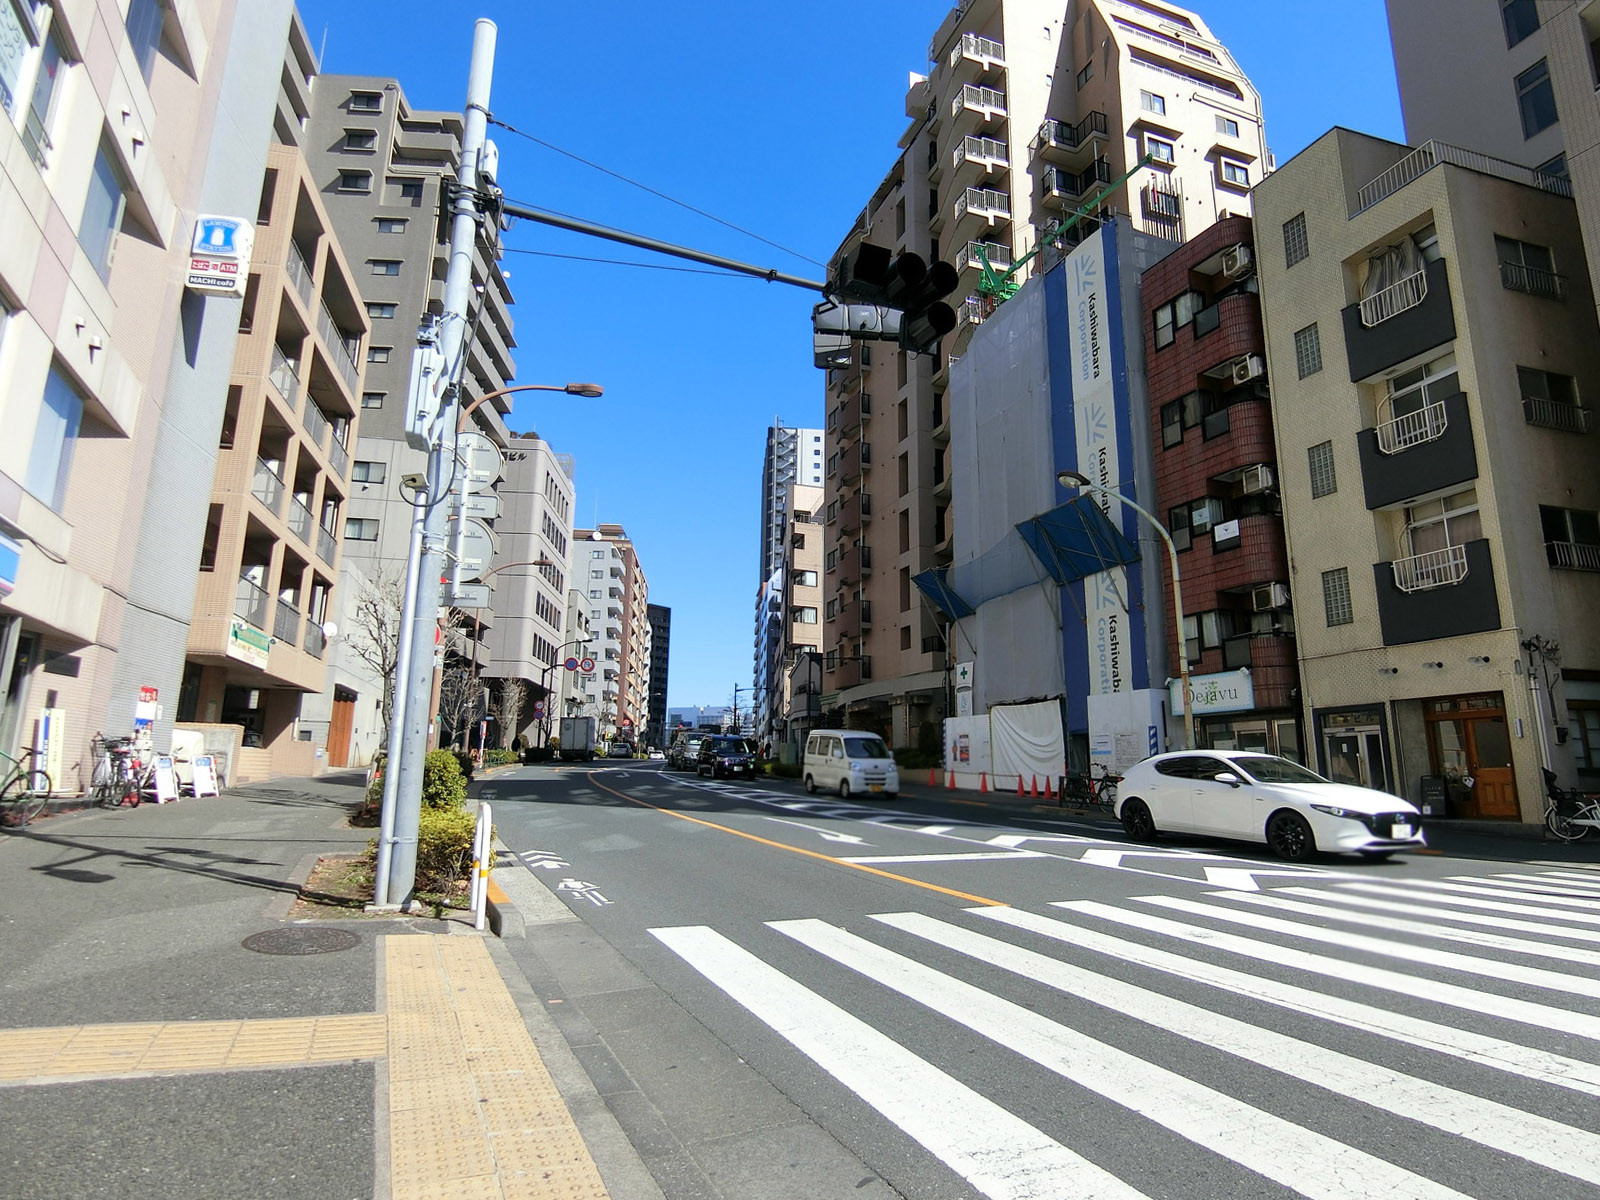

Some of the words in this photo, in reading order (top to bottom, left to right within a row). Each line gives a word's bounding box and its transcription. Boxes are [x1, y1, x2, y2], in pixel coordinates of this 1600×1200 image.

[190, 276, 217, 285] MACHI
[220, 264, 237, 272] ATM
[1078, 301, 1089, 381] Corporation
[1088, 292, 1100, 379] Kashiwabara
